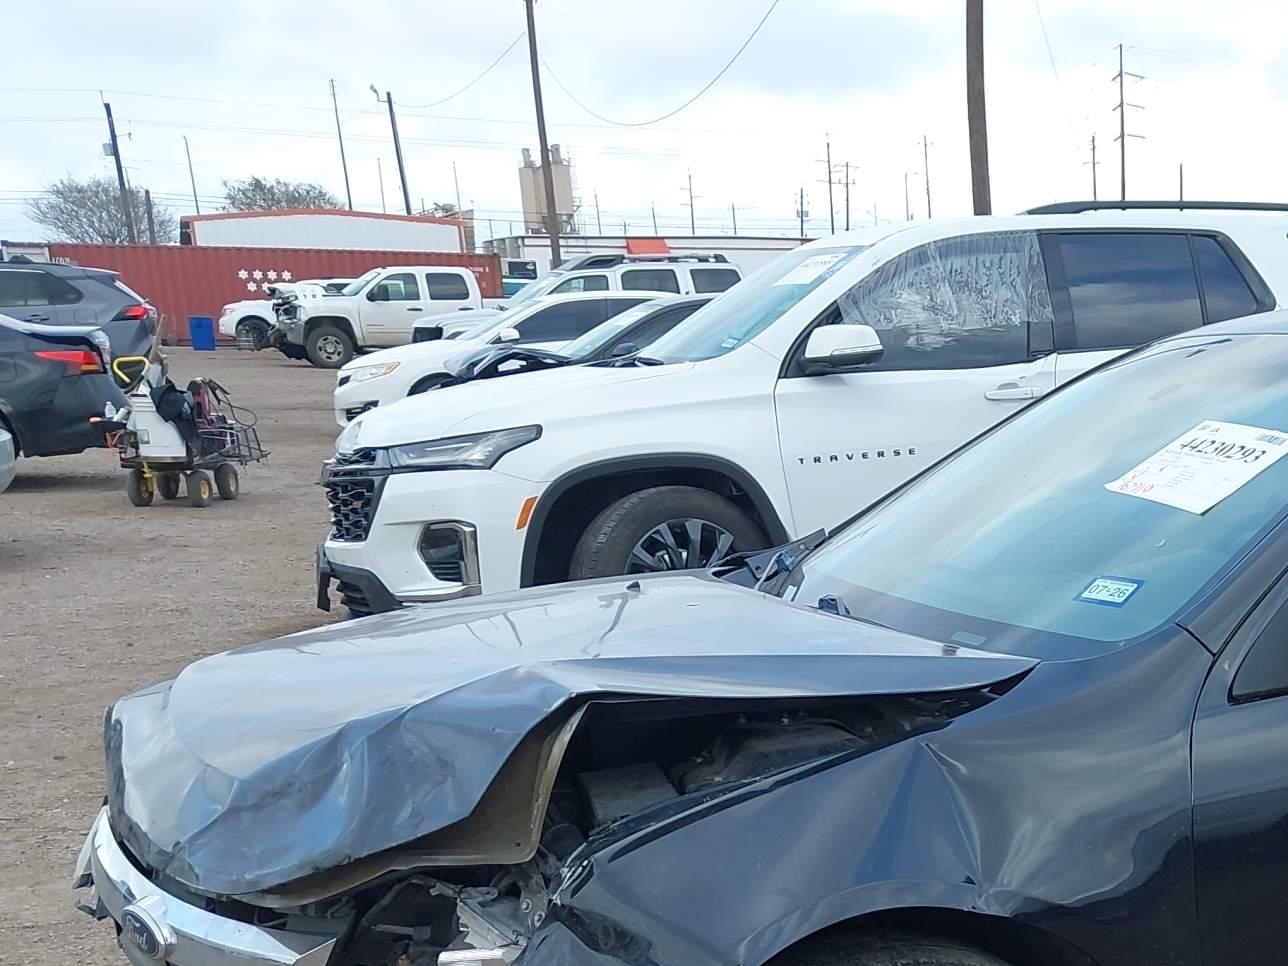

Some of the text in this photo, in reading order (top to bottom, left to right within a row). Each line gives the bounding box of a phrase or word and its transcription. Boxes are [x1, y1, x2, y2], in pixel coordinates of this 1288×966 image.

[797, 447, 916, 465] TRAVERSE
[1179, 438, 1267, 463] 44230293
[126, 914, 149, 951] Ford
